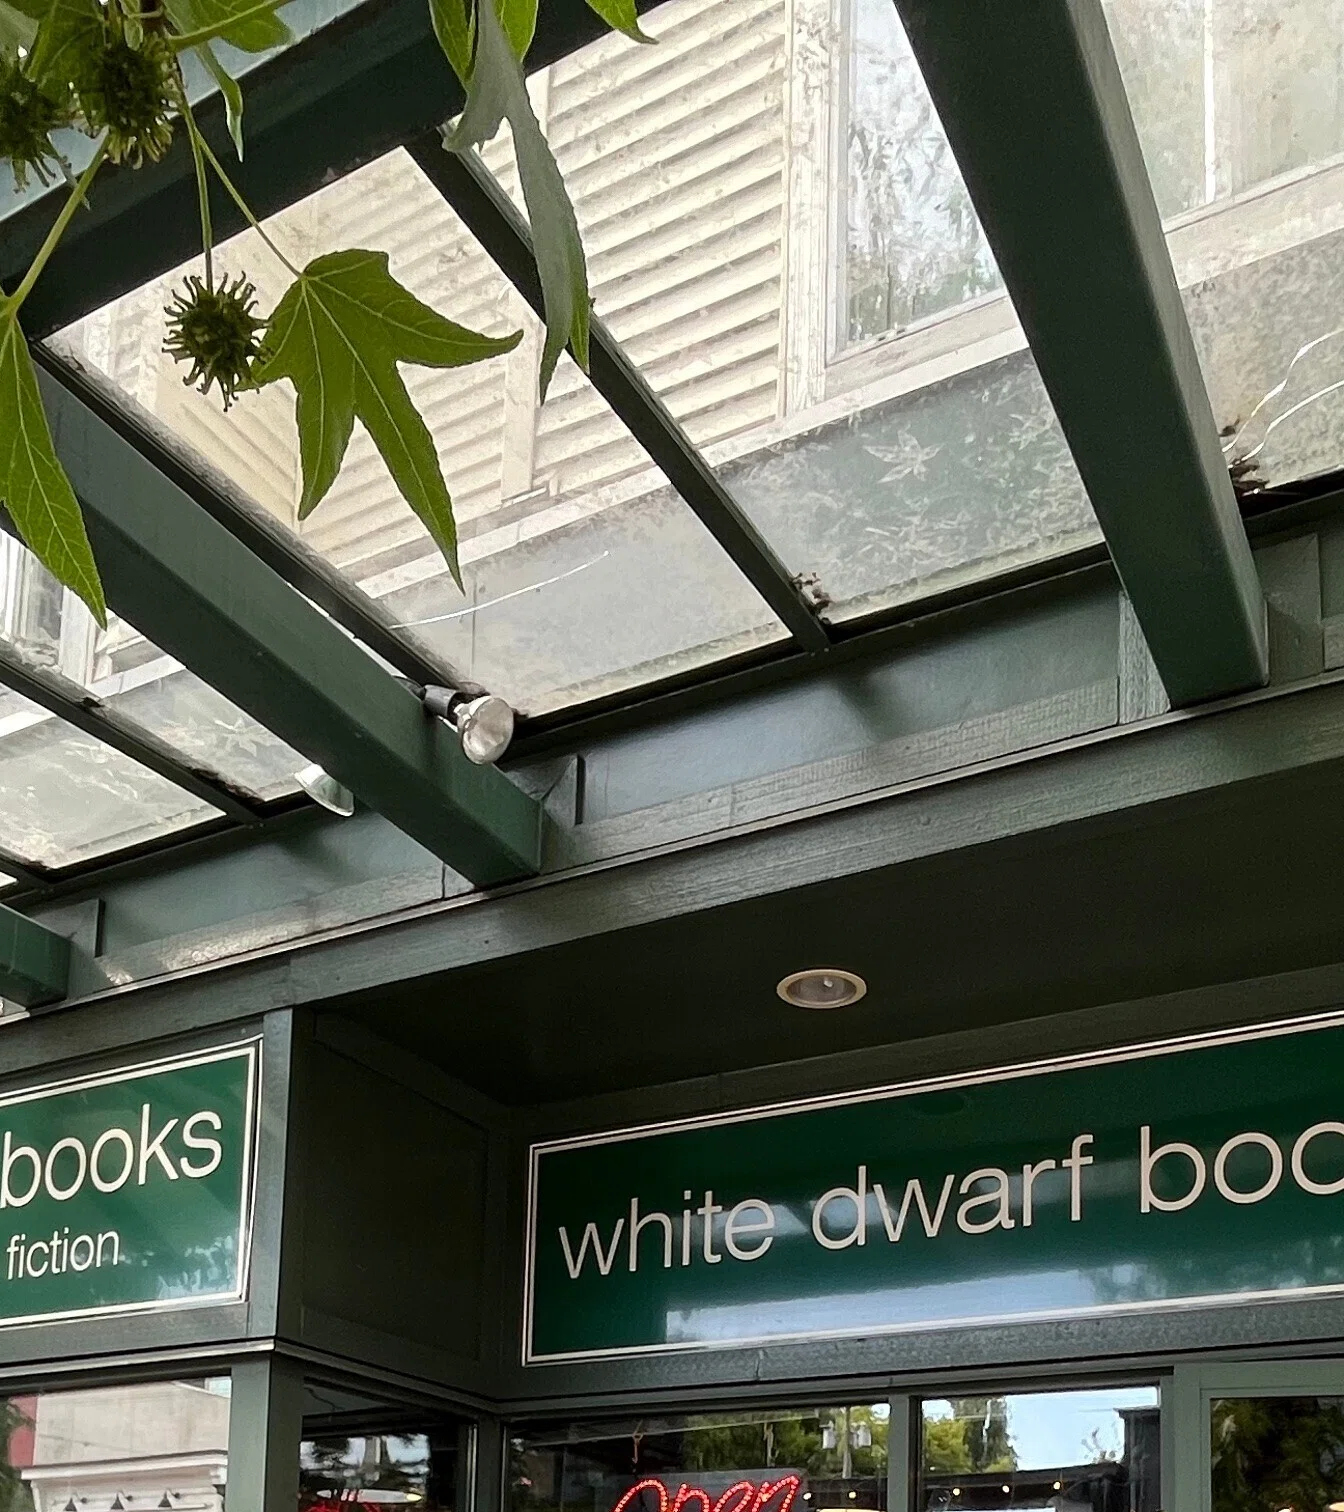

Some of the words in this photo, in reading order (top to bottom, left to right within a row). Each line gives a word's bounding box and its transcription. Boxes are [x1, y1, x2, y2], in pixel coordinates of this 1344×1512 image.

[0, 1103, 223, 1209] books
[558, 1189, 777, 1280] white
[811, 1134, 1094, 1251] dwarf
[6, 1226, 120, 1280] fiction
